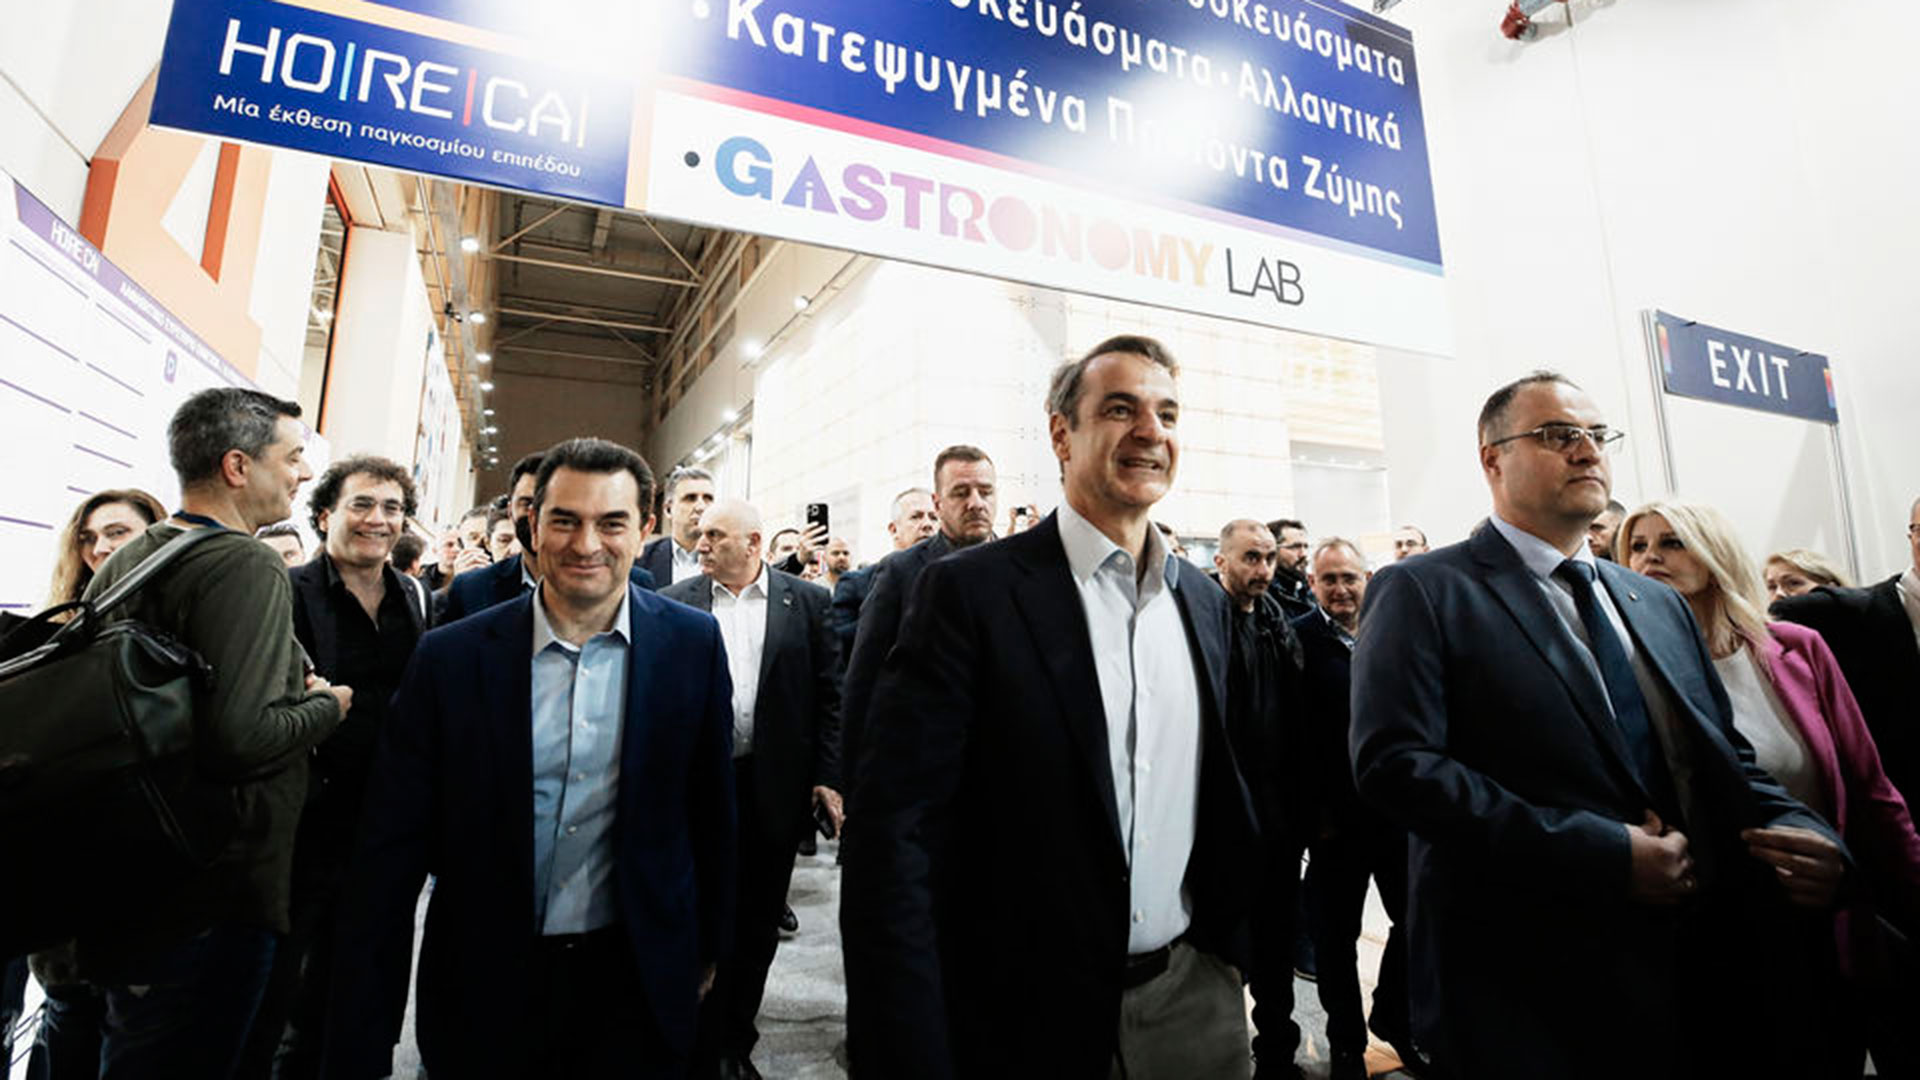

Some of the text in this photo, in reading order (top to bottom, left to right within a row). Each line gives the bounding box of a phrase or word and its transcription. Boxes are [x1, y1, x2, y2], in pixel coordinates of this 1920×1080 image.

[949, 0, 1402, 150] κευάσματα Αλλαντικά
[1187, 0, 1404, 85] σκευάσματα
[213, 94, 581, 177] Μία έκθεση παγκοσμίου επιπέδου
[727, 0, 1086, 133] Κατεψυγμένα
[1301, 155, 1403, 229] Ζύμης
[714, 136, 1304, 306] GASTRONOMY LAB
[1707, 339, 1790, 400] EXIT
